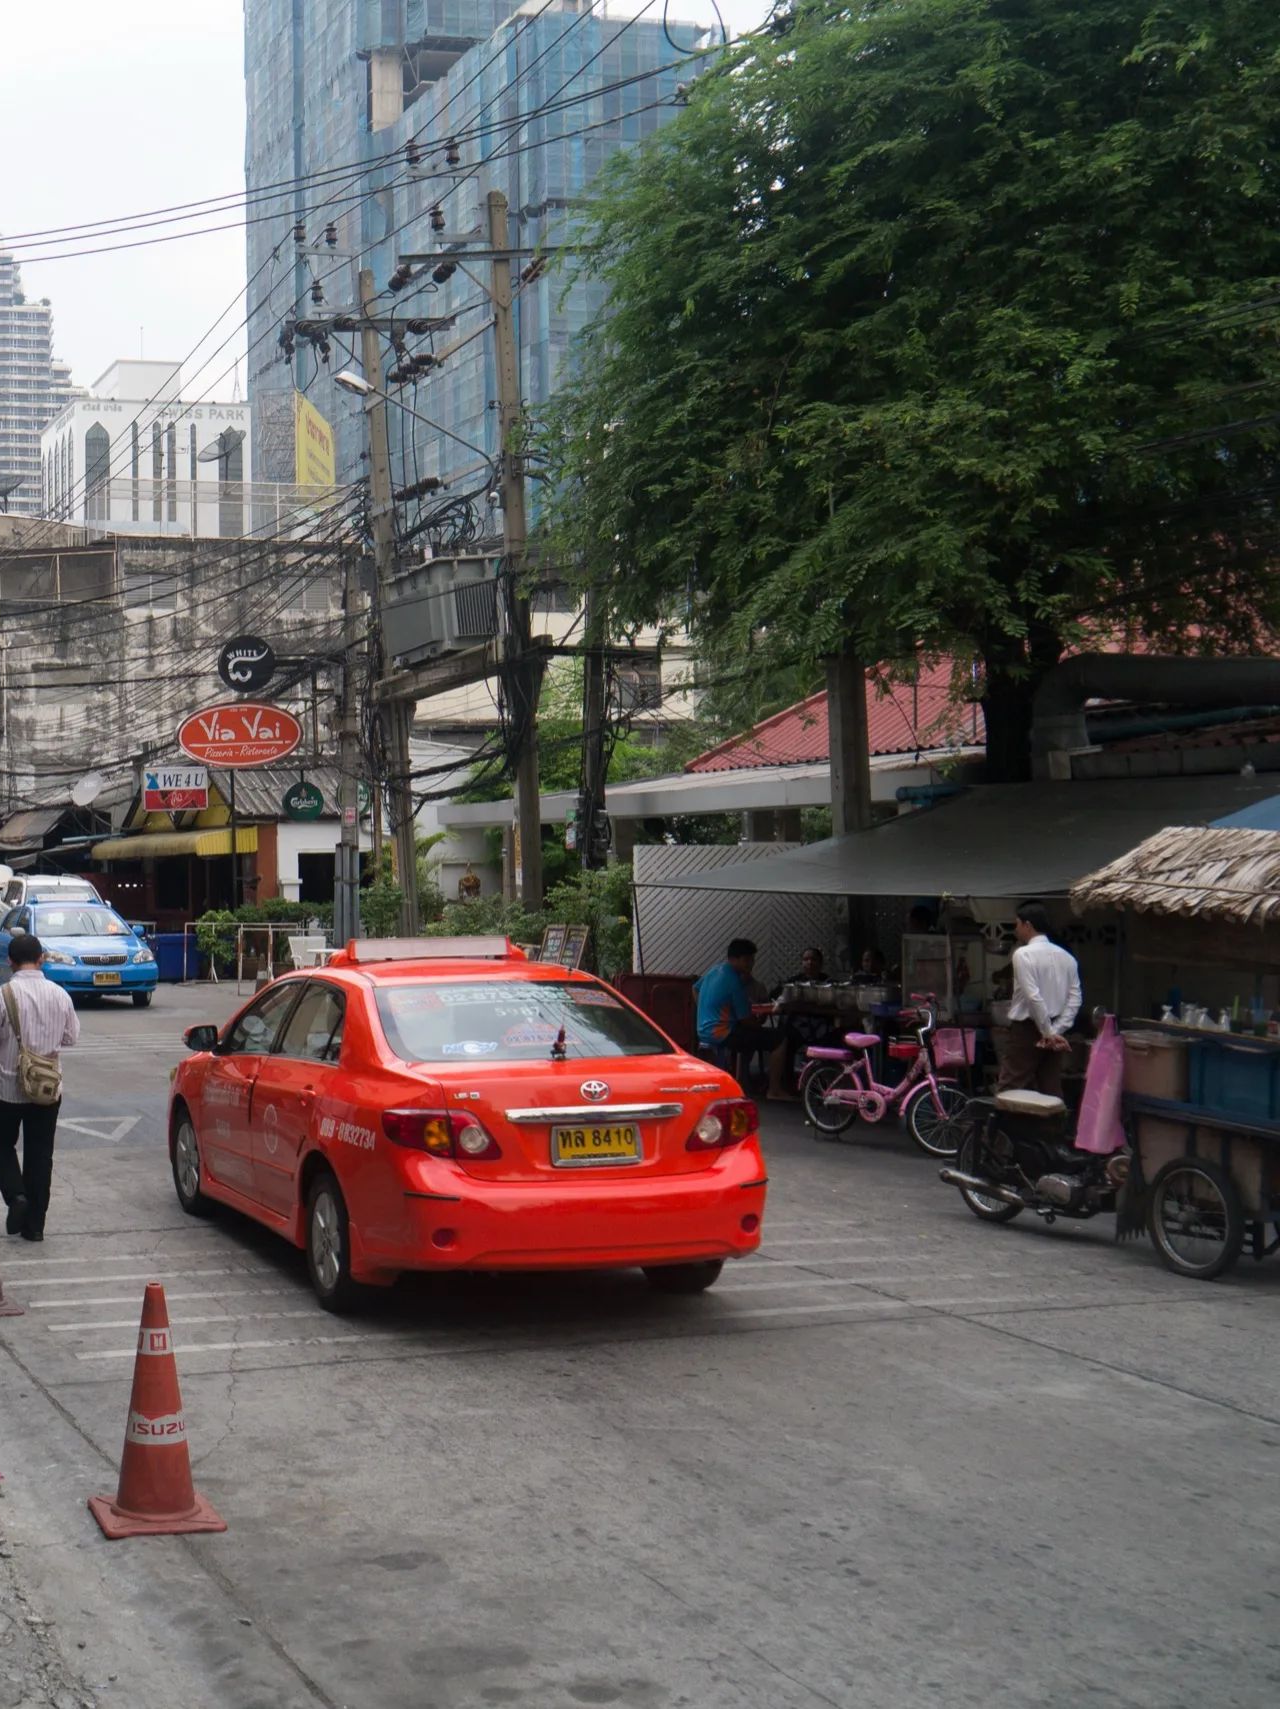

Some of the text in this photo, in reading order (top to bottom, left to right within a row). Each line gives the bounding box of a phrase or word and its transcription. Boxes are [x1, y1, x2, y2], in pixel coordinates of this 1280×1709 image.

[158, 406, 245, 420] SWISS PARK
[199, 710, 280, 740] Via Vai
[204, 747, 233, 757] Pizzeria
[240, 745, 278, 756] Ristorante
[163, 773, 204, 787] WE 4 U
[592, 1128, 634, 1146] 8410
[132, 1420, 185, 1435] ISUZU
